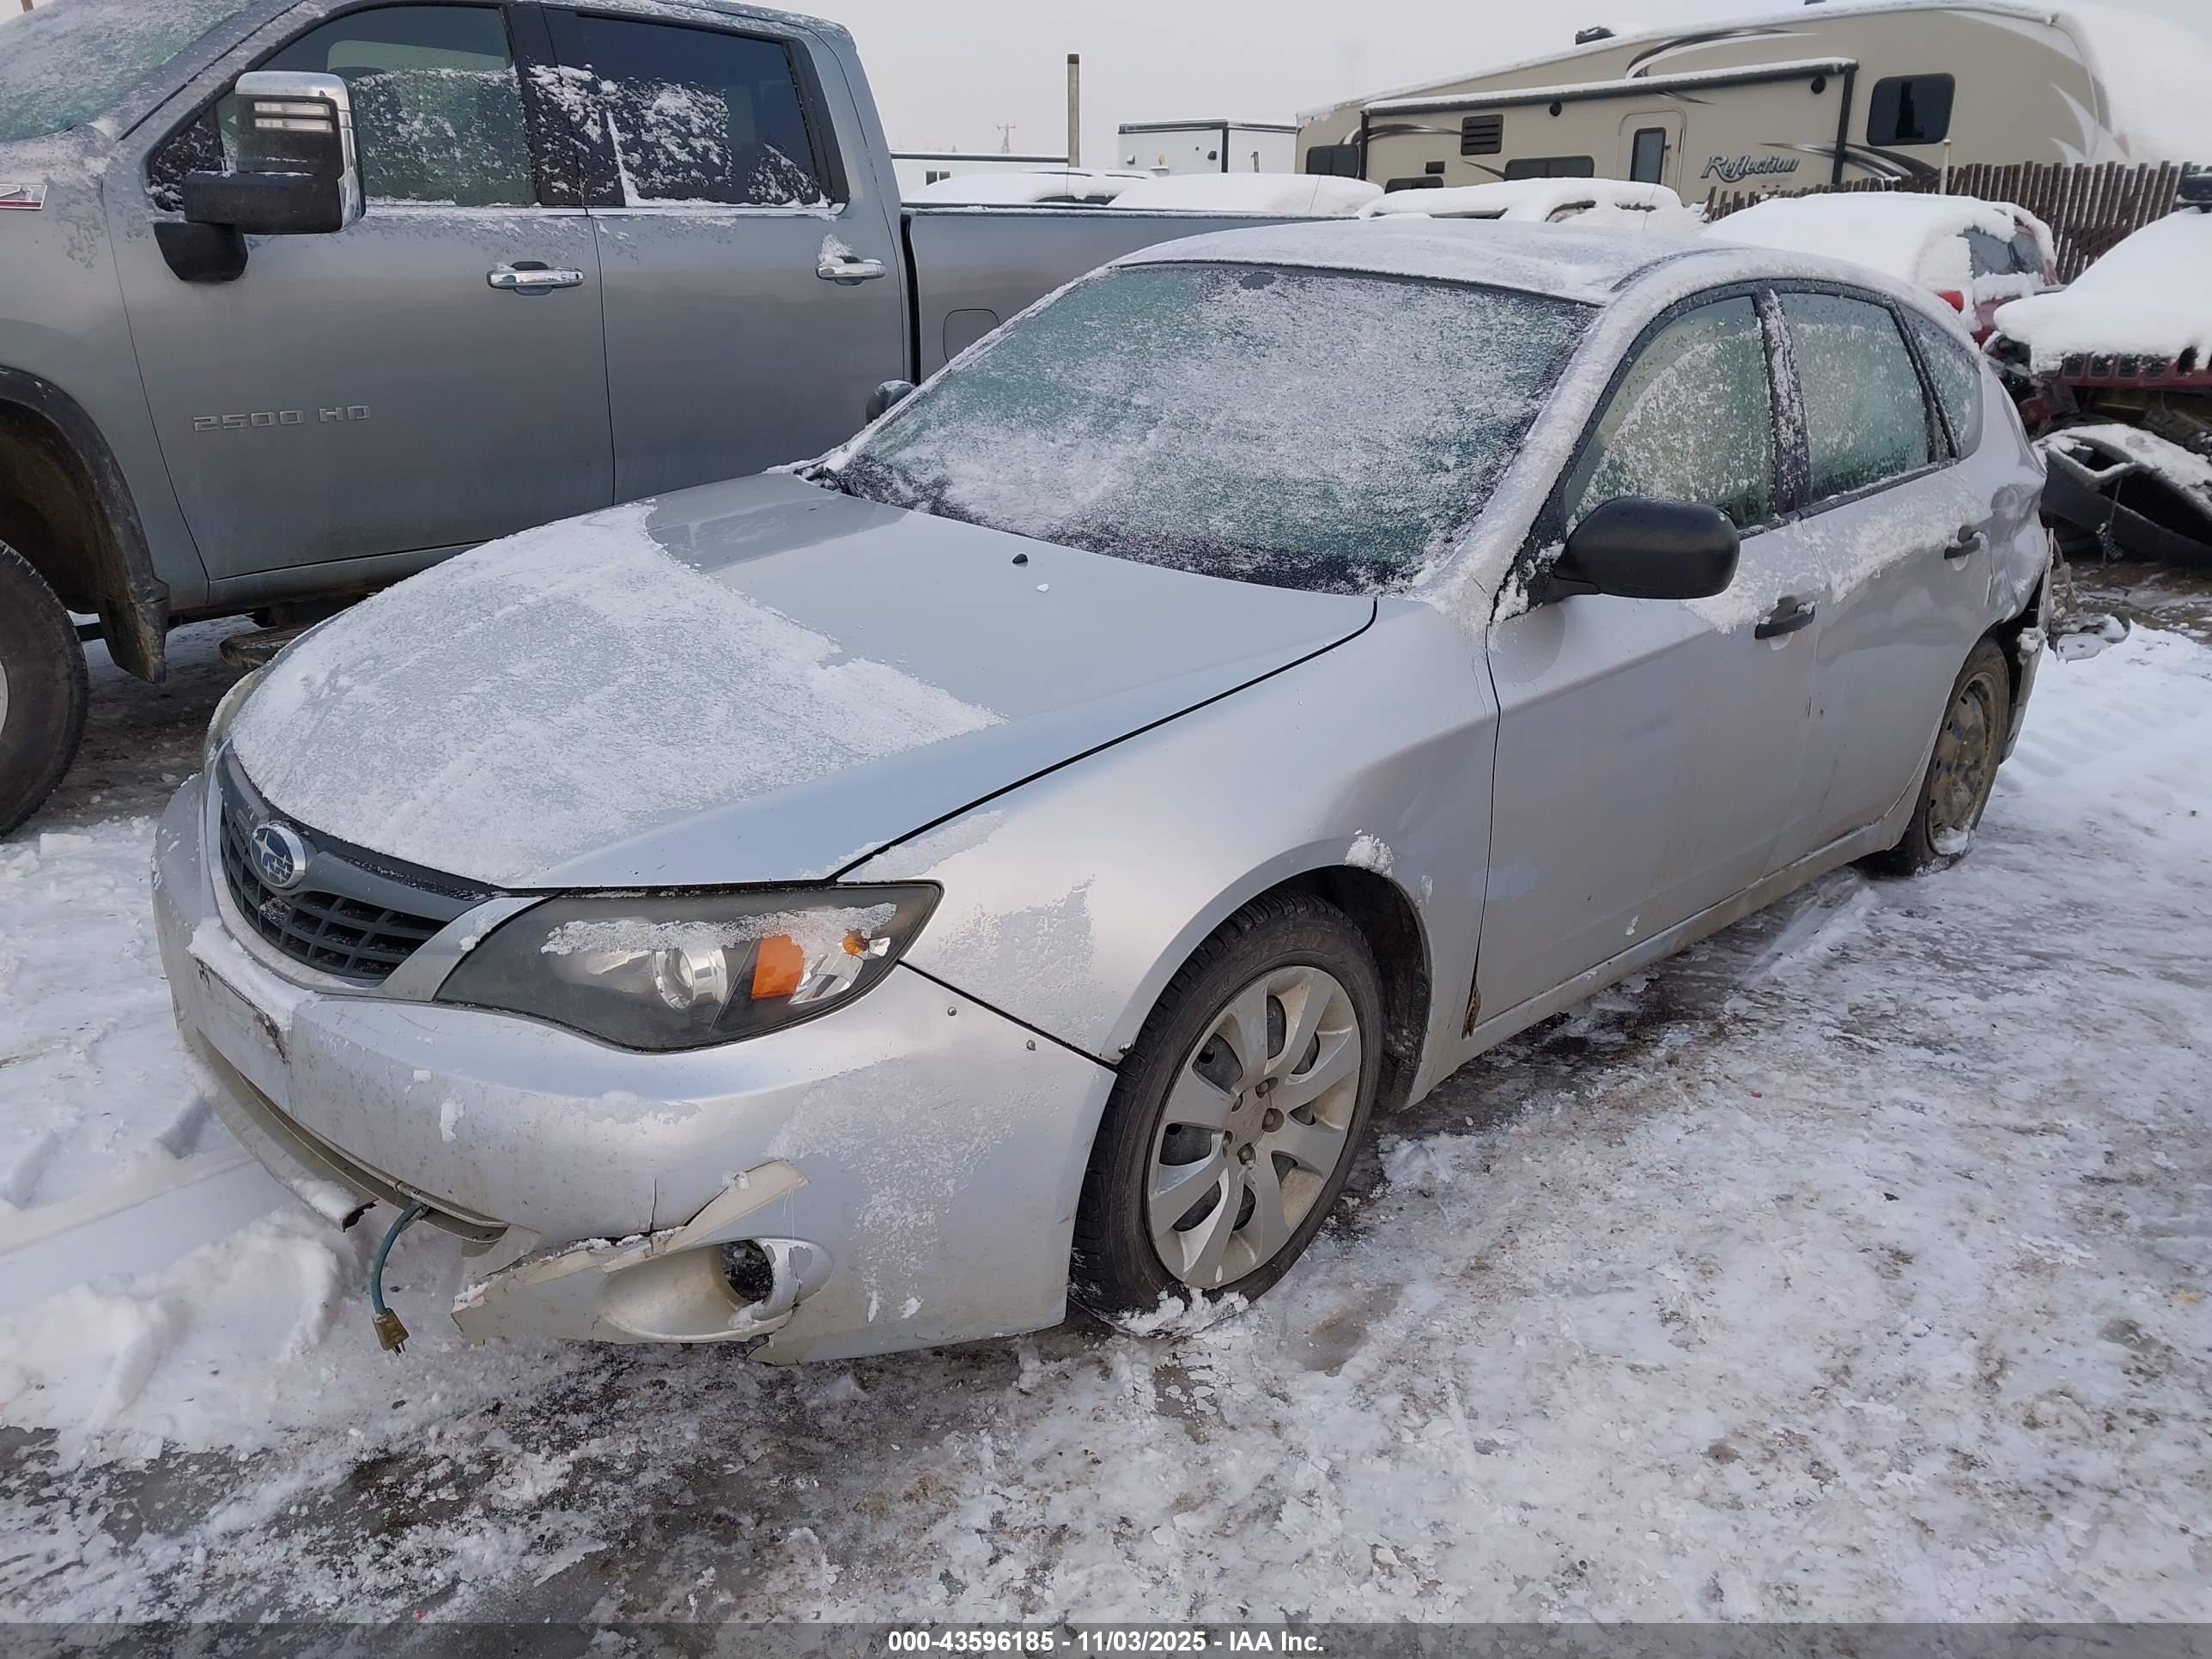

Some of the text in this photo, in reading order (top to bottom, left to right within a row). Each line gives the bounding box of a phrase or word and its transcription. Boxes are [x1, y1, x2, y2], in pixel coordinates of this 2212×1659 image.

[1700, 155, 1800, 183] Reflection
[192, 405, 371, 431] 2500 HD
